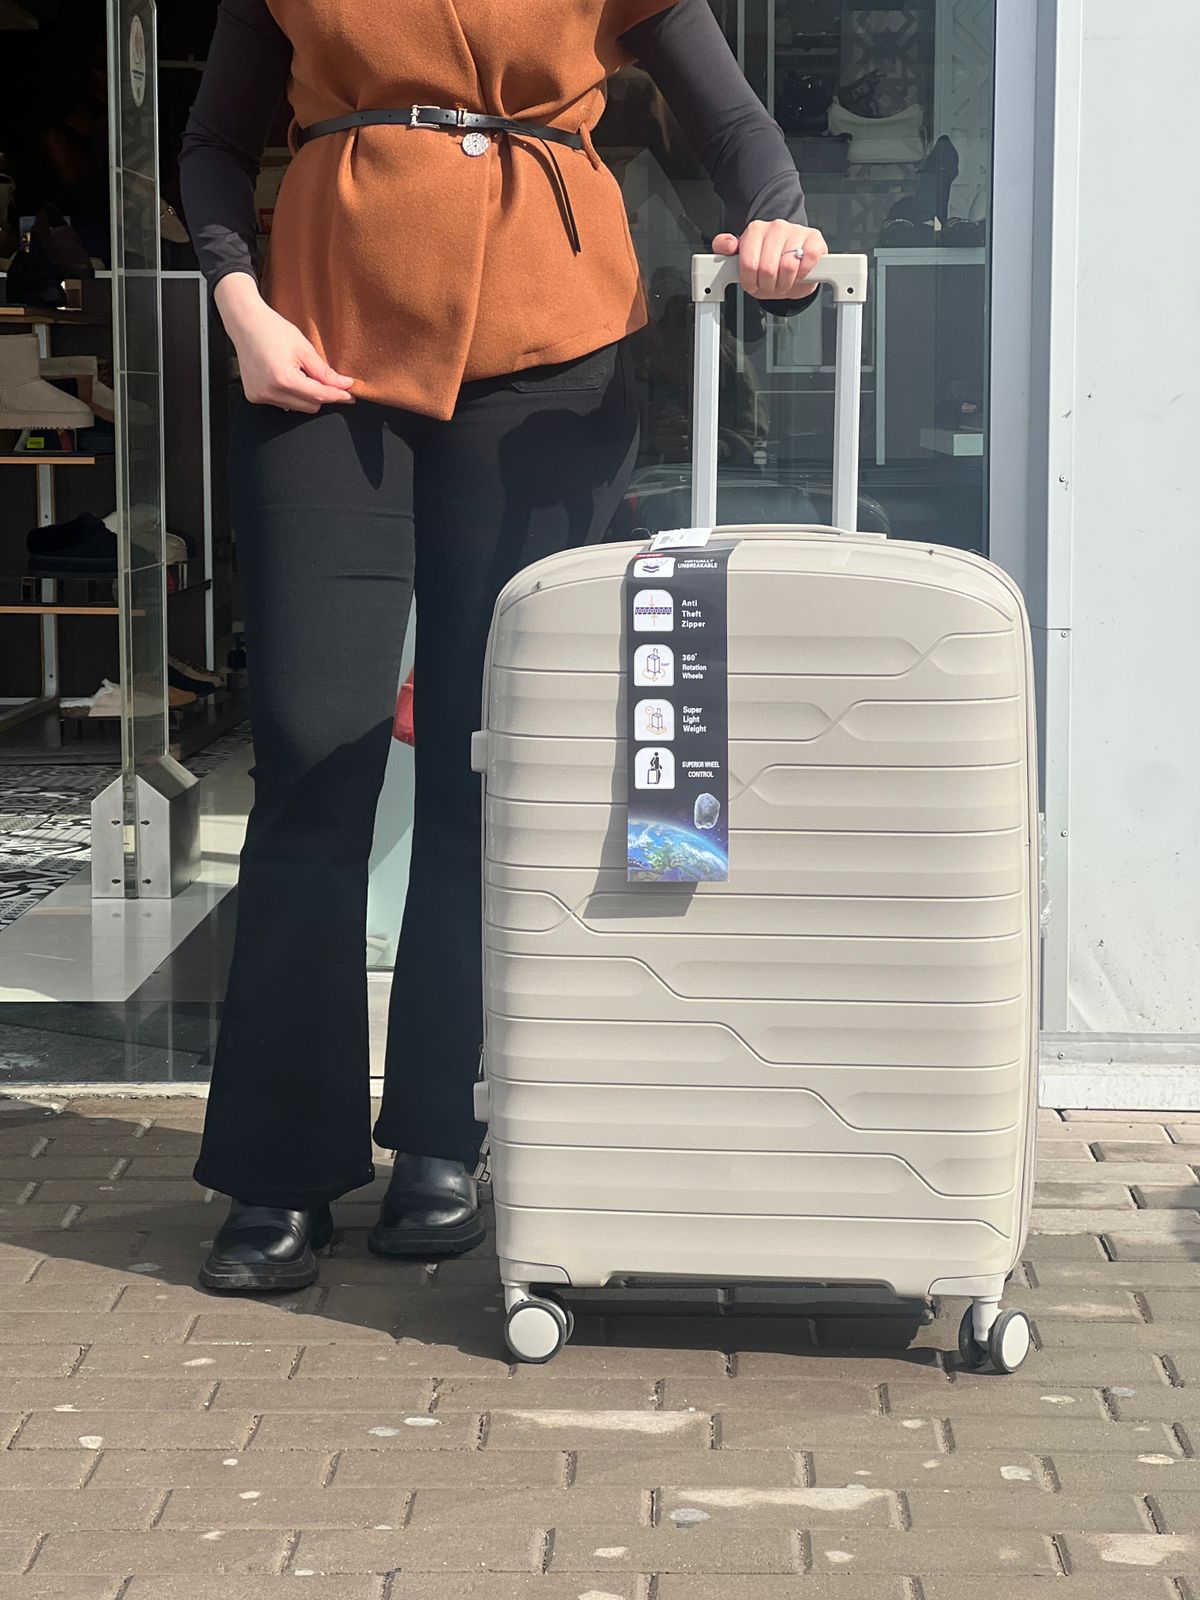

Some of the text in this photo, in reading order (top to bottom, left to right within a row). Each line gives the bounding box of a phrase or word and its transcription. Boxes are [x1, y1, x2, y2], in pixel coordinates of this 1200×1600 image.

[681, 599, 698, 607] Anti
[681, 610, 702, 618] Theft
[681, 620, 706, 629] Zipper
[682, 705, 703, 715] Super
[682, 715, 700, 724] Light
[682, 724, 707, 734] Weight
[687, 770, 714, 778] CONTROL
